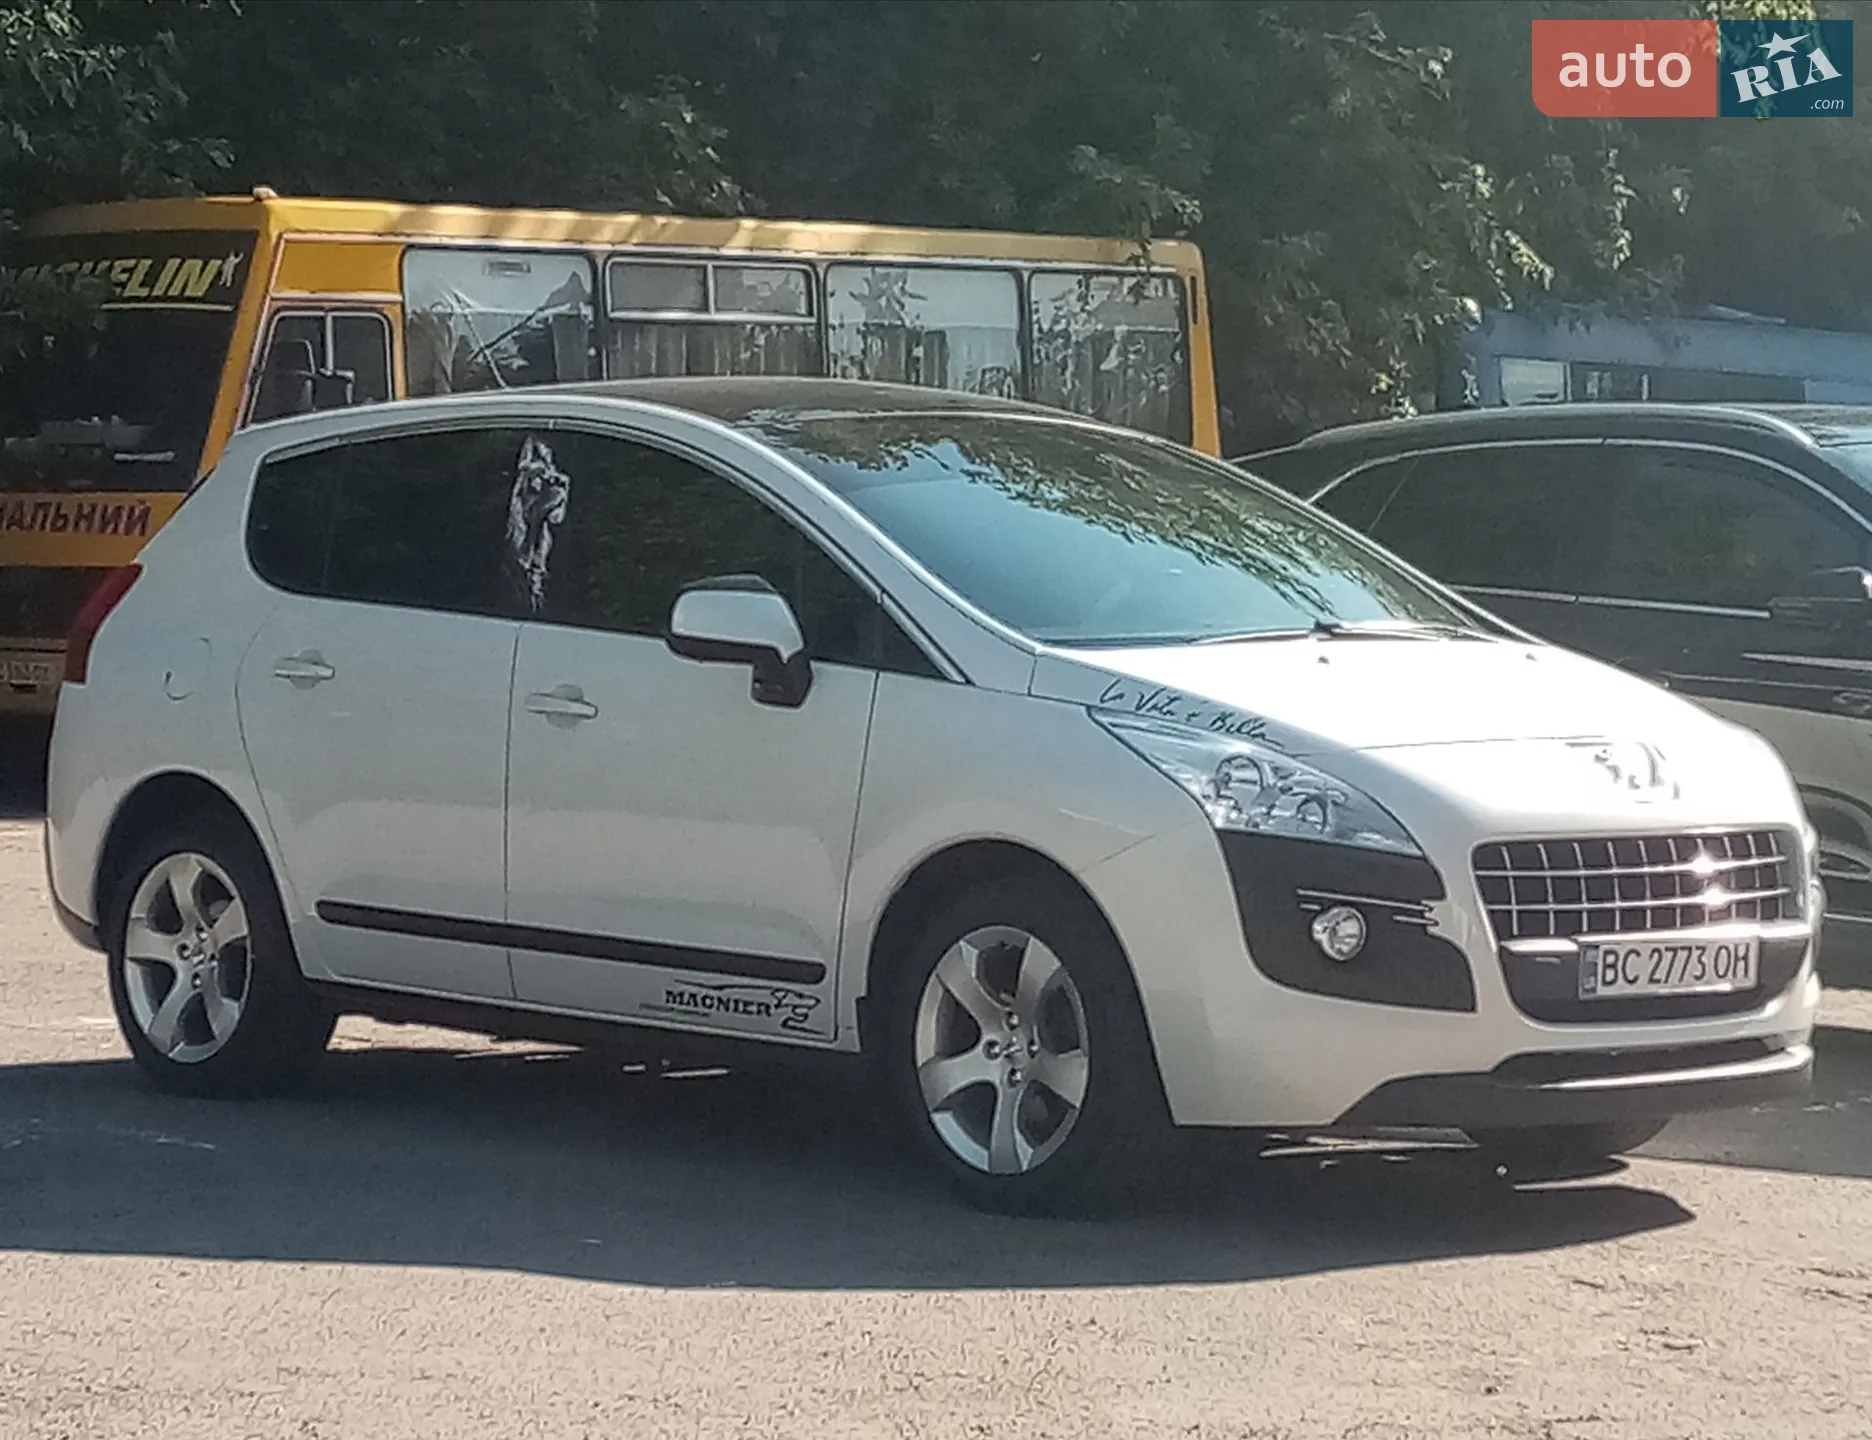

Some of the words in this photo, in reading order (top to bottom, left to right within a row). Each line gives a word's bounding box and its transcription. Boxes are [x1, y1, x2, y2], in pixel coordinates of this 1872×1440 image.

[0, 256, 224, 298] ELIN
[0, 498, 152, 537] АЛЬНИЙ
[1601, 947, 1642, 987] BC
[1647, 945, 1708, 985] 2773
[1713, 942, 1751, 980] OH
